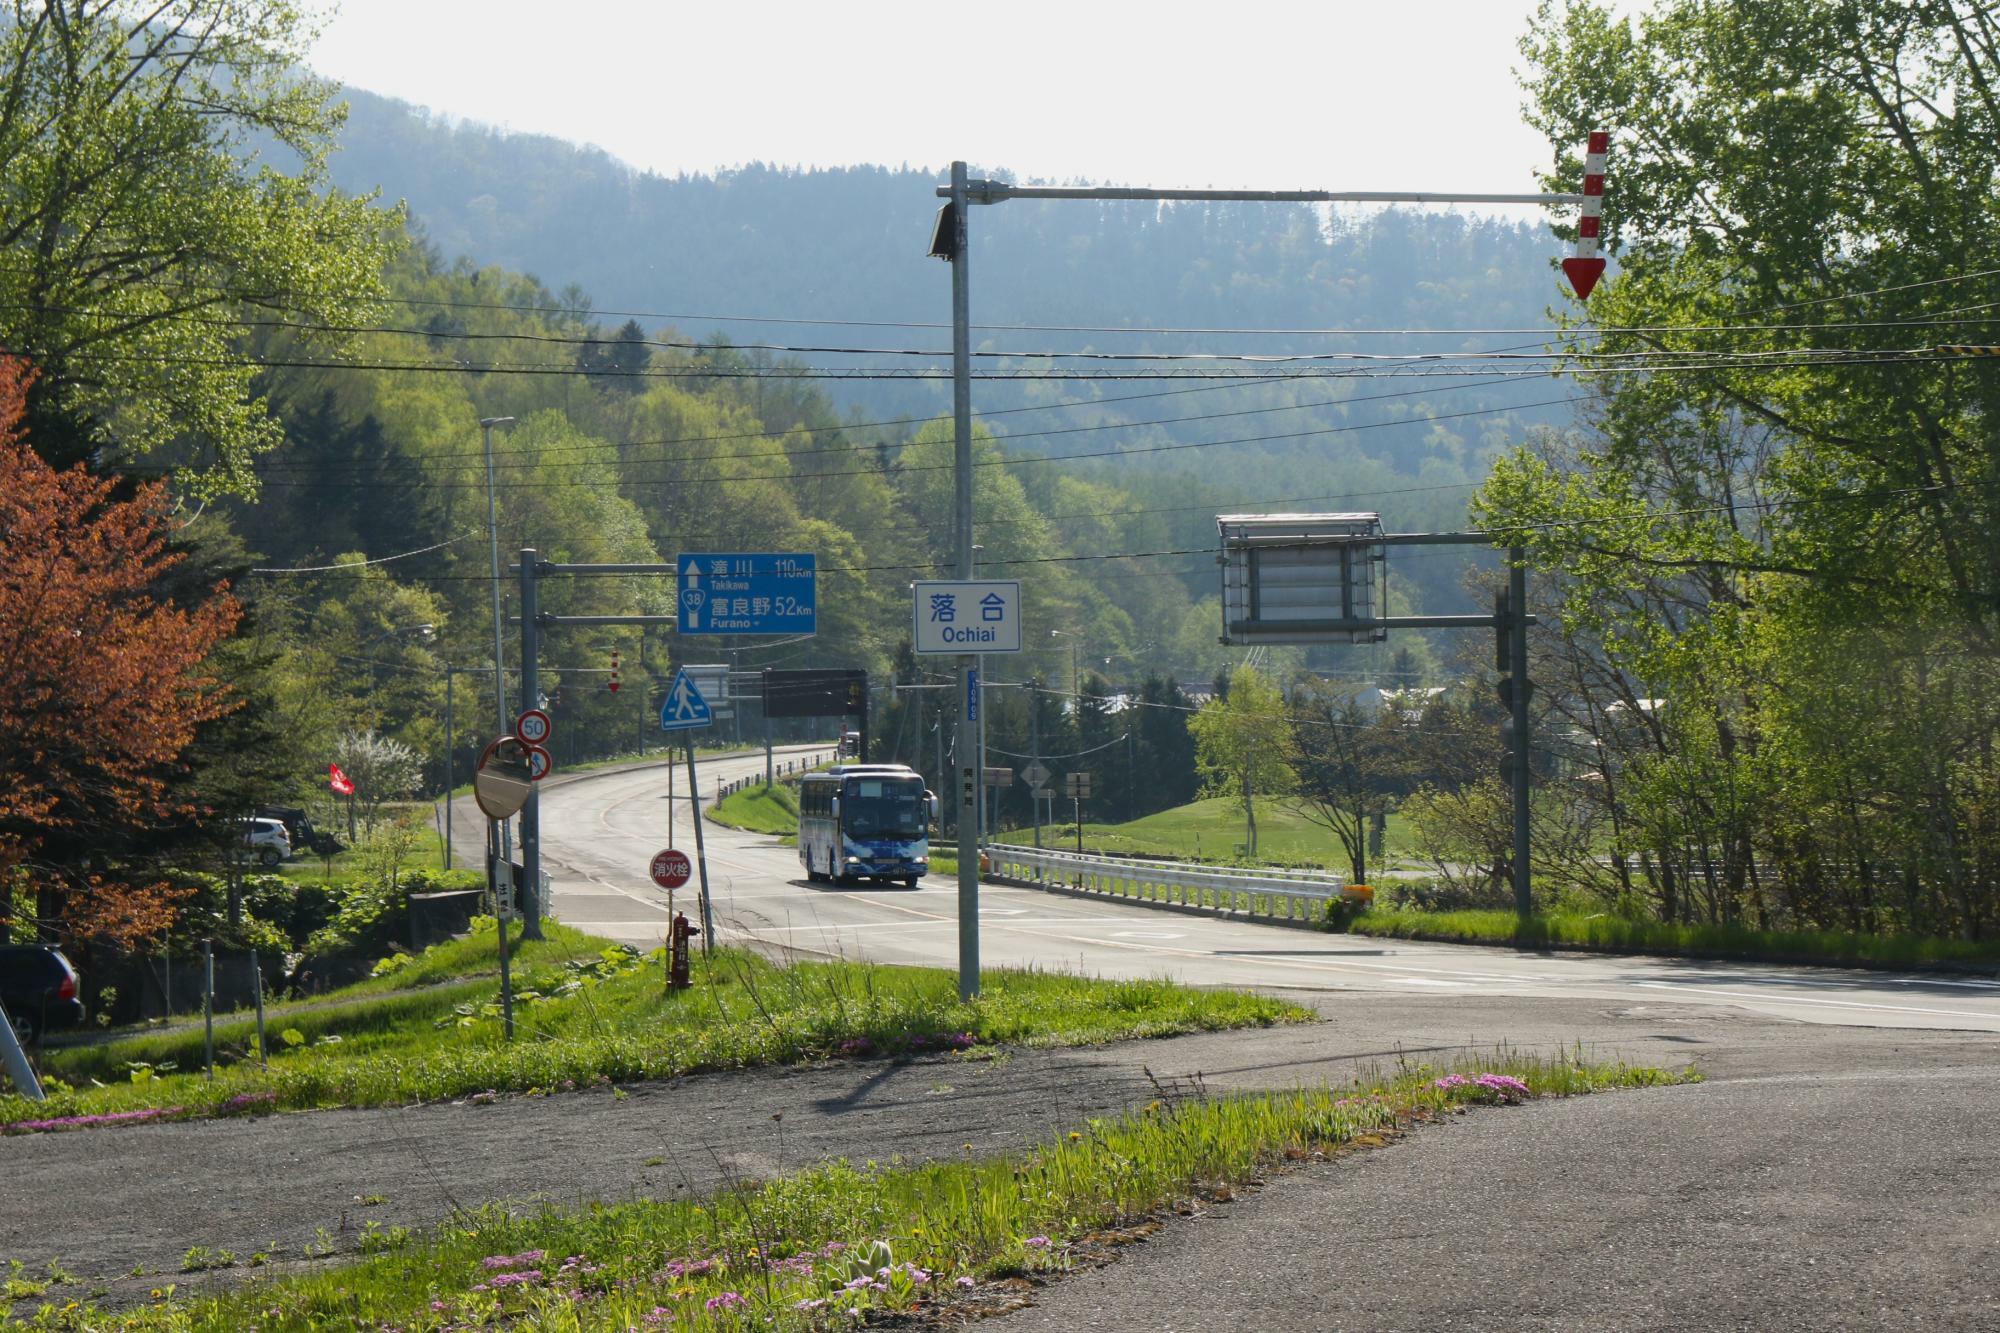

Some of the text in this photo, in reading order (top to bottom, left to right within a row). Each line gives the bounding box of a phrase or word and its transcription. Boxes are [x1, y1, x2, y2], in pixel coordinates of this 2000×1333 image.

[711, 559, 752, 578] 滝川
[711, 580, 749, 590] Takikawa
[687, 593, 700, 605] 38
[711, 597, 771, 616] 富良野
[930, 592, 1005, 622] 落合
[710, 618, 750, 628] Furano
[942, 626, 995, 643] Ochiai
[524, 720, 543, 736] 50
[654, 862, 689, 878] 消火栓
